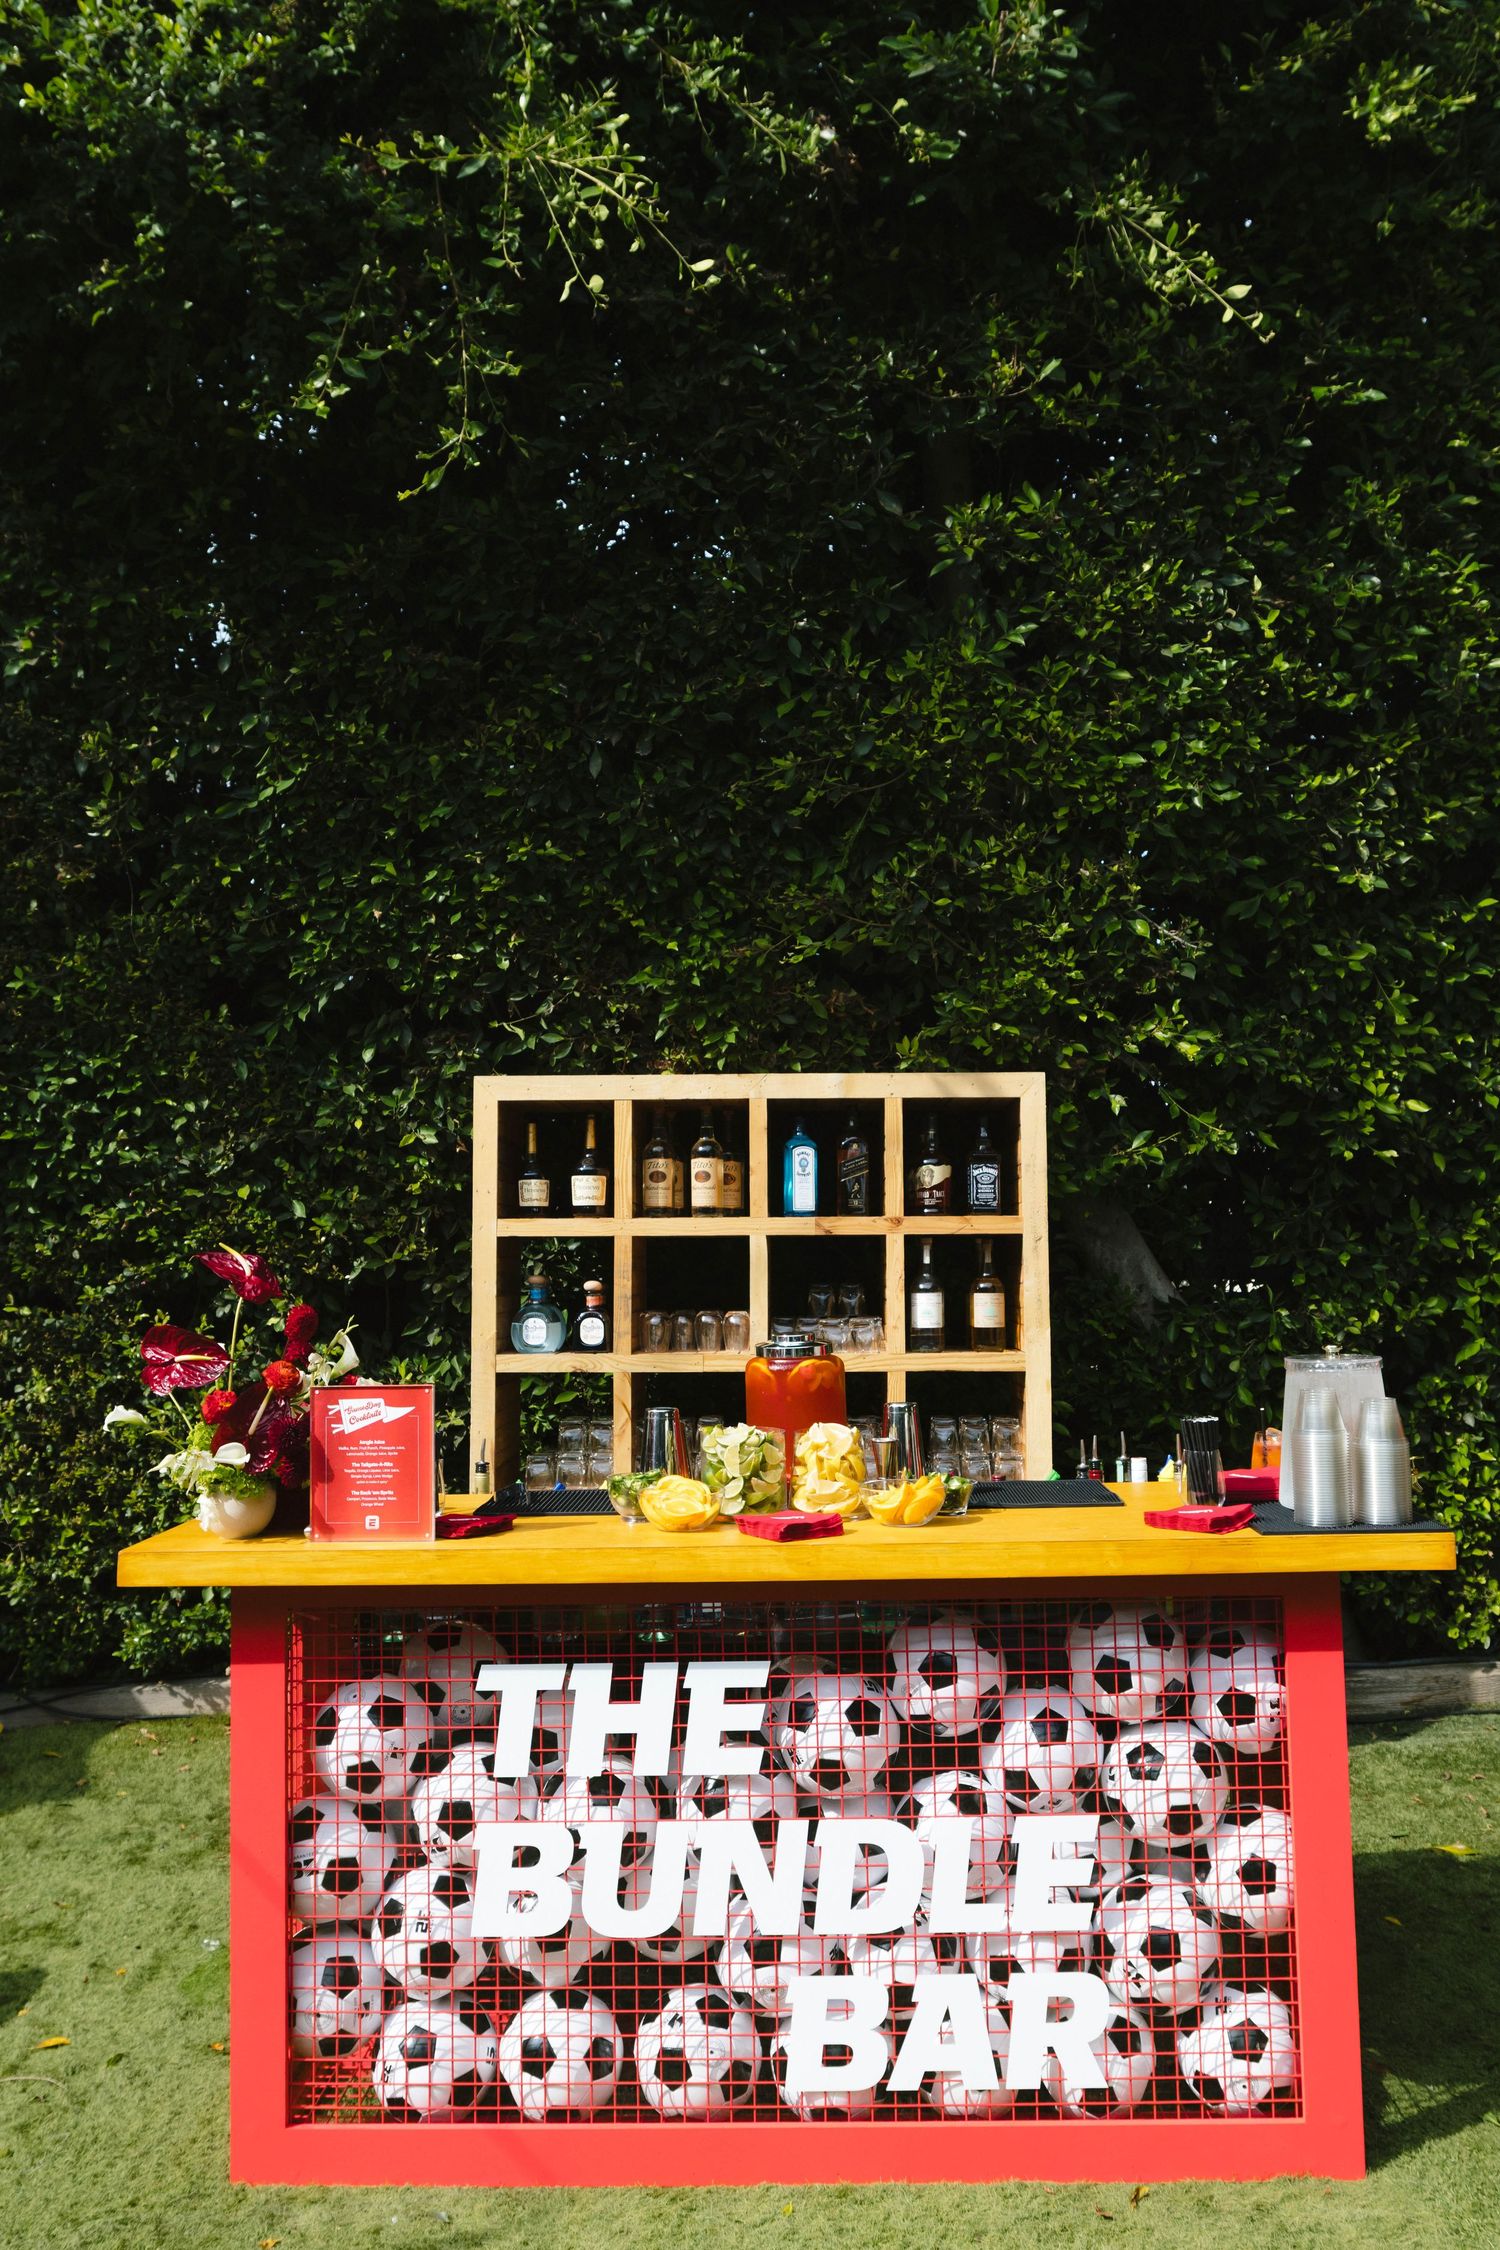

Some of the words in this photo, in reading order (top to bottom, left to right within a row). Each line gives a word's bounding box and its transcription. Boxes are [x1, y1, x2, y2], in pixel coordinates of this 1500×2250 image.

[647, 1160, 670, 1169] Tito's
[692, 1160, 714, 1169] Tito's
[474, 1662, 772, 1778] THE
[471, 1815, 1101, 1938] BUNDLE
[784, 1972, 1111, 2092] BAR
